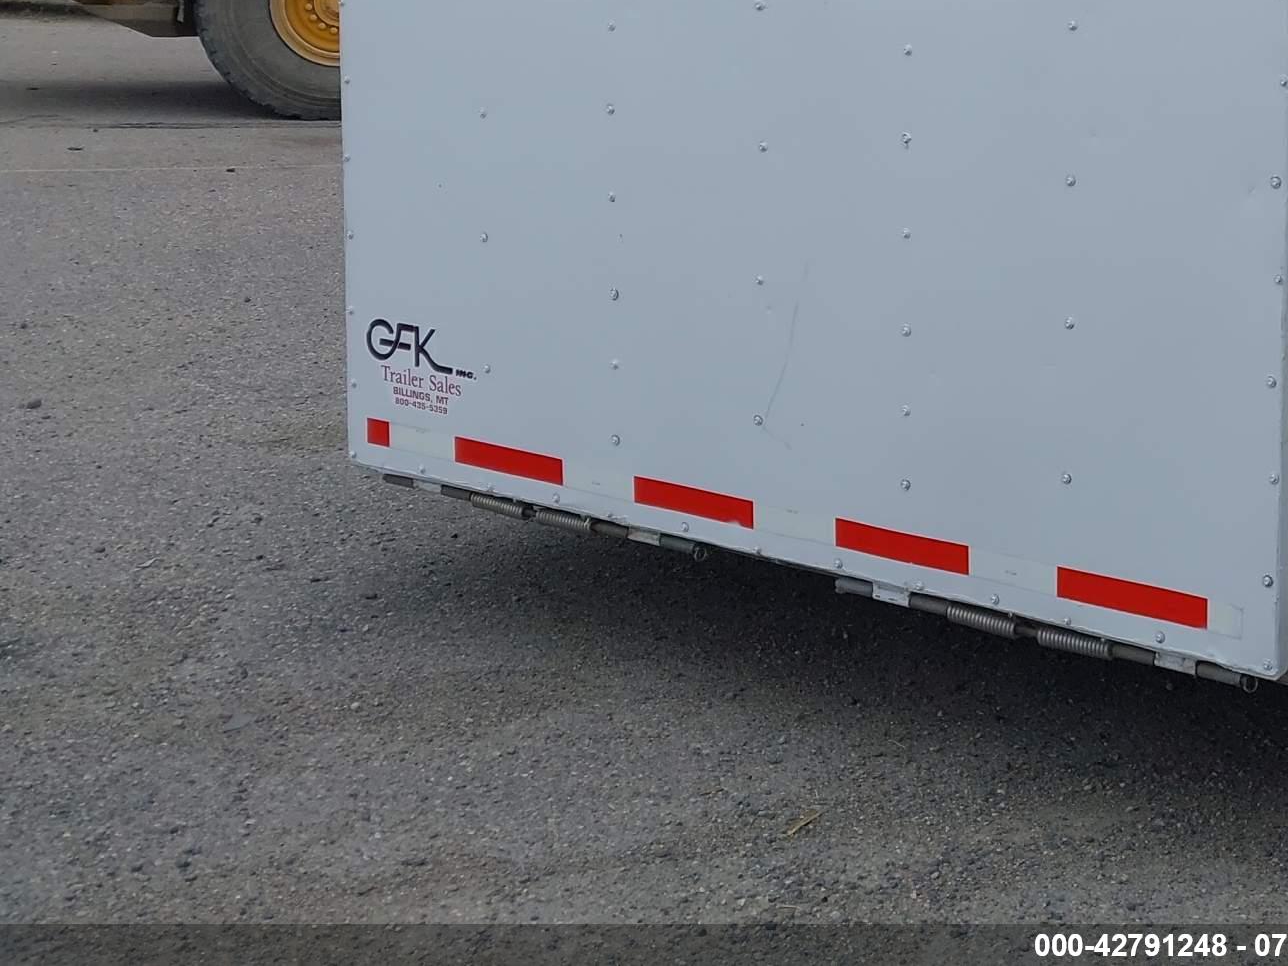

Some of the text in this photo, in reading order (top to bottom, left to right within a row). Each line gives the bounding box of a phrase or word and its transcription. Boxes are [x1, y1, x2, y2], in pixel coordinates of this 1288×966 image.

[381, 365, 462, 397] Trailer Sales
[393, 386, 449, 405] BILLINGS, MT
